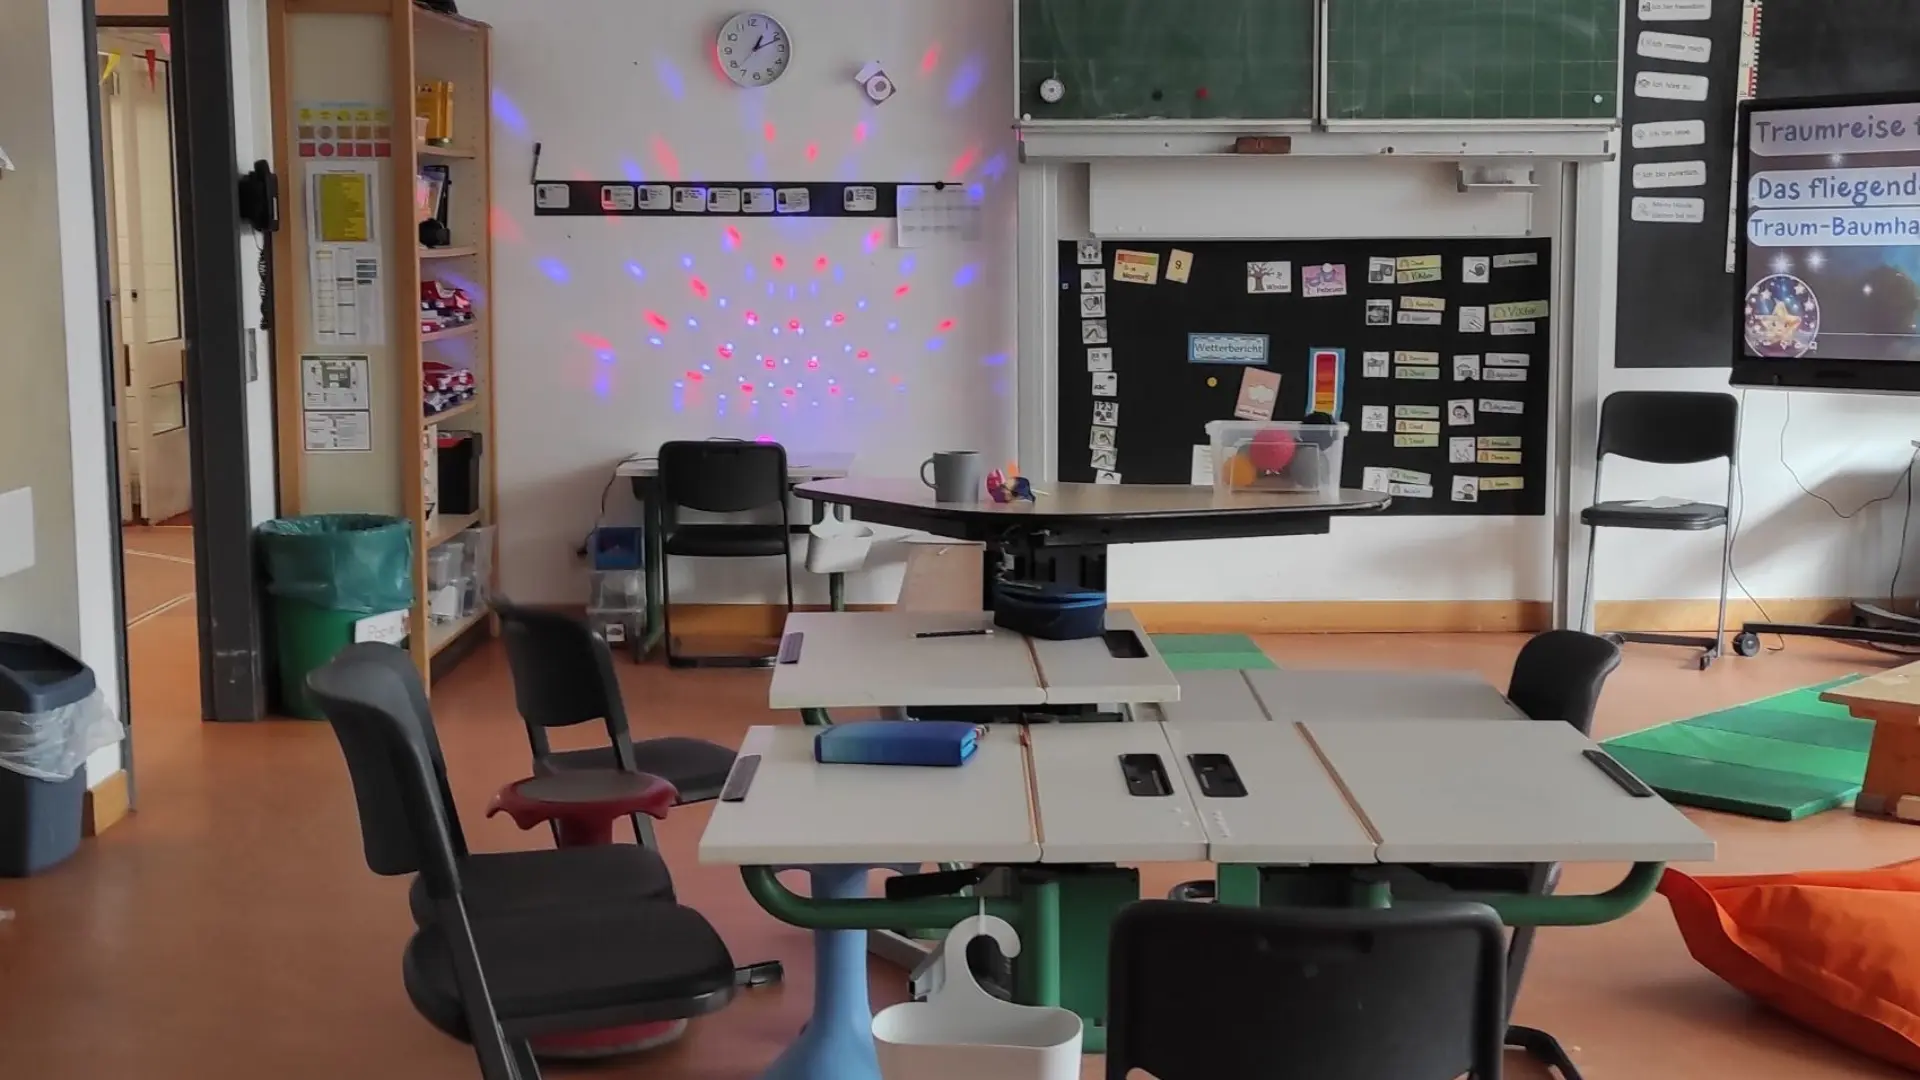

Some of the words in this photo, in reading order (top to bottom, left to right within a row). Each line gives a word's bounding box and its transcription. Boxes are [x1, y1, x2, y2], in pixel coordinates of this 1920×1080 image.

[737, 23, 745, 32] 11
[747, 19, 759, 27] 12
[727, 33, 738, 42] 10
[773, 31, 781, 41] 2
[723, 46, 733, 56] 9
[776, 43, 785, 53] 3
[729, 60, 738, 69] 8
[774, 57, 783, 65] 4
[739, 69, 748, 79] 7
[752, 71, 761, 81] 6
[766, 67, 775, 77] 5
[1756, 115, 1905, 143] Traumreise
[1758, 177, 1800, 201] Das
[1808, 172, 1920, 207] fliegend
[1174, 260, 1184, 271] 9.
[1194, 343, 1263, 353] Wetterbericht
[1096, 402, 1113, 412] 123
